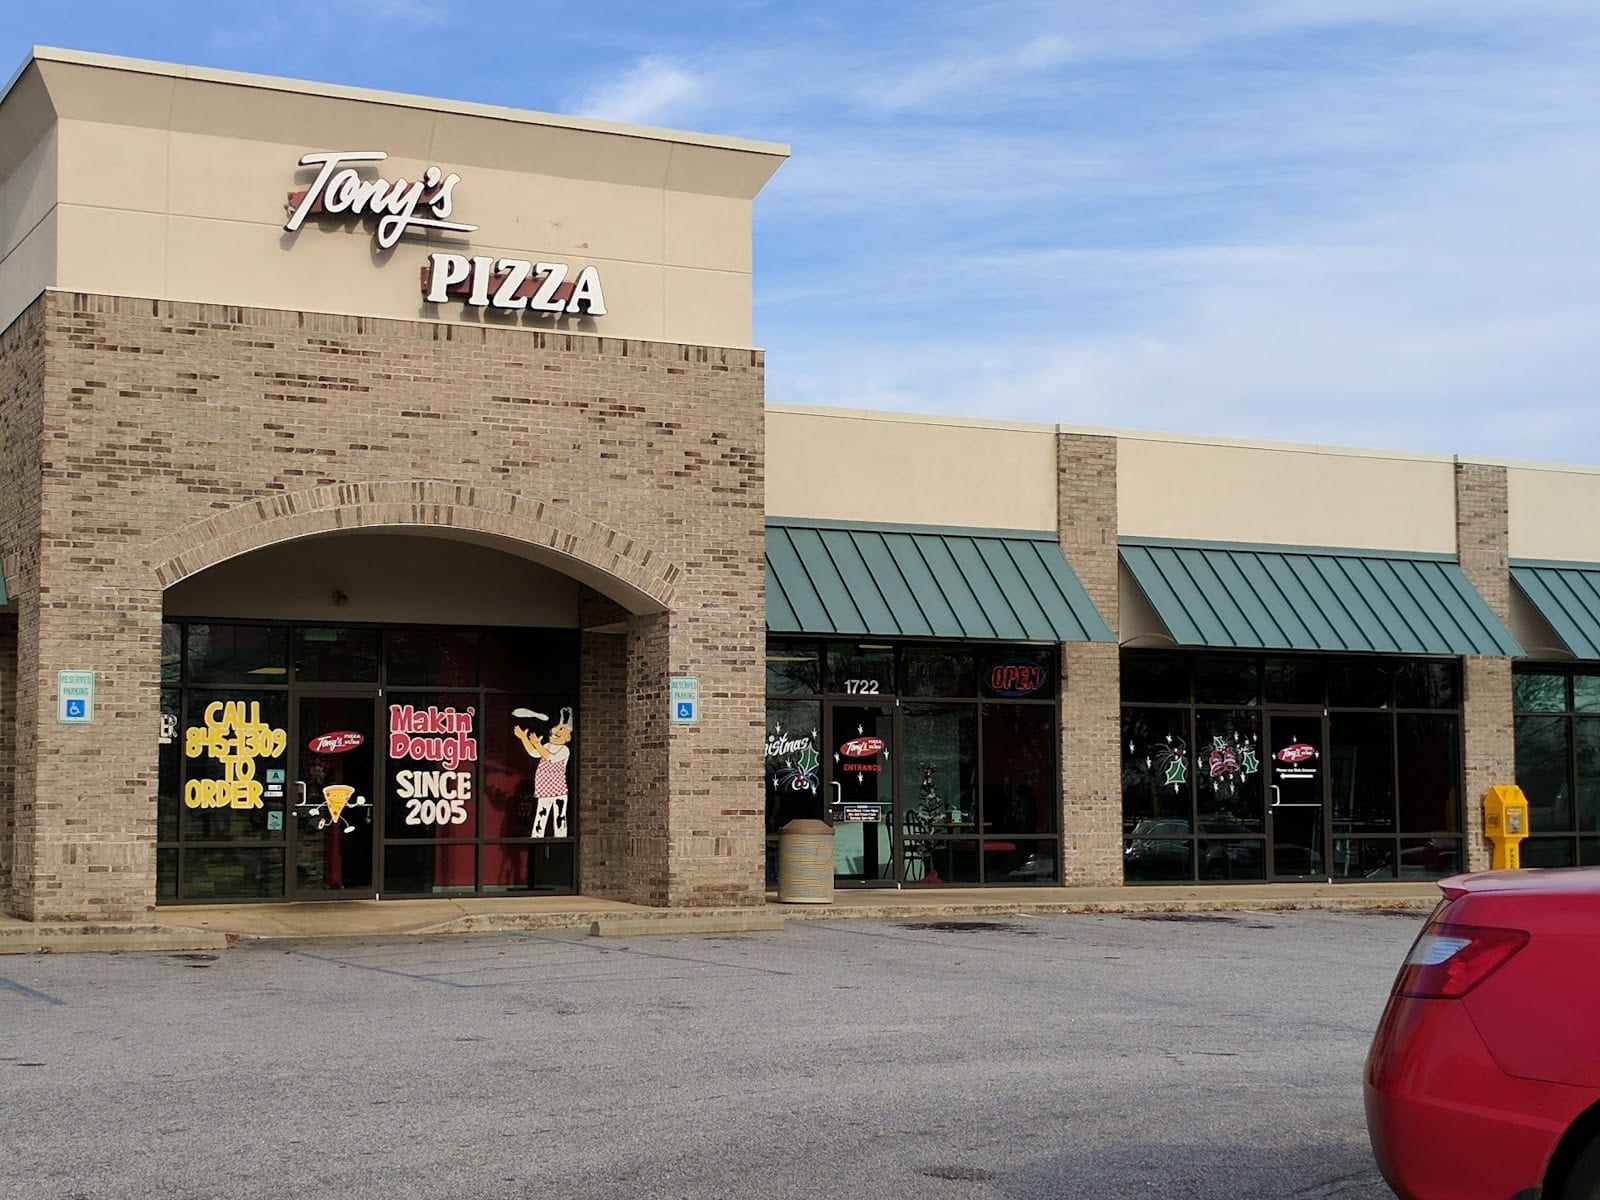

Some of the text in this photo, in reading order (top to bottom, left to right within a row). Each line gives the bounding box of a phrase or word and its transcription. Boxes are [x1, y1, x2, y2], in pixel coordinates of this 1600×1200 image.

[284, 151, 479, 249] Tony's
[426, 253, 608, 316] PIZZA
[61, 675, 92, 683] RESERVED
[64, 687, 88, 695] PARKING
[844, 679, 879, 695] 1722
[991, 665, 1040, 690] OPEN
[204, 701, 269, 729] CALL
[390, 704, 475, 733] Makin'
[186, 727, 287, 758] 845-1309
[316, 735, 345, 751] Tony's
[390, 731, 477, 770] Dough
[847, 741, 869, 755] Tony's
[219, 755, 256, 782] TO
[843, 763, 882, 771] ENTRANCE
[184, 779, 264, 809] ORDER
[396, 769, 471, 799] SINCE
[405, 799, 467, 826] 2005
